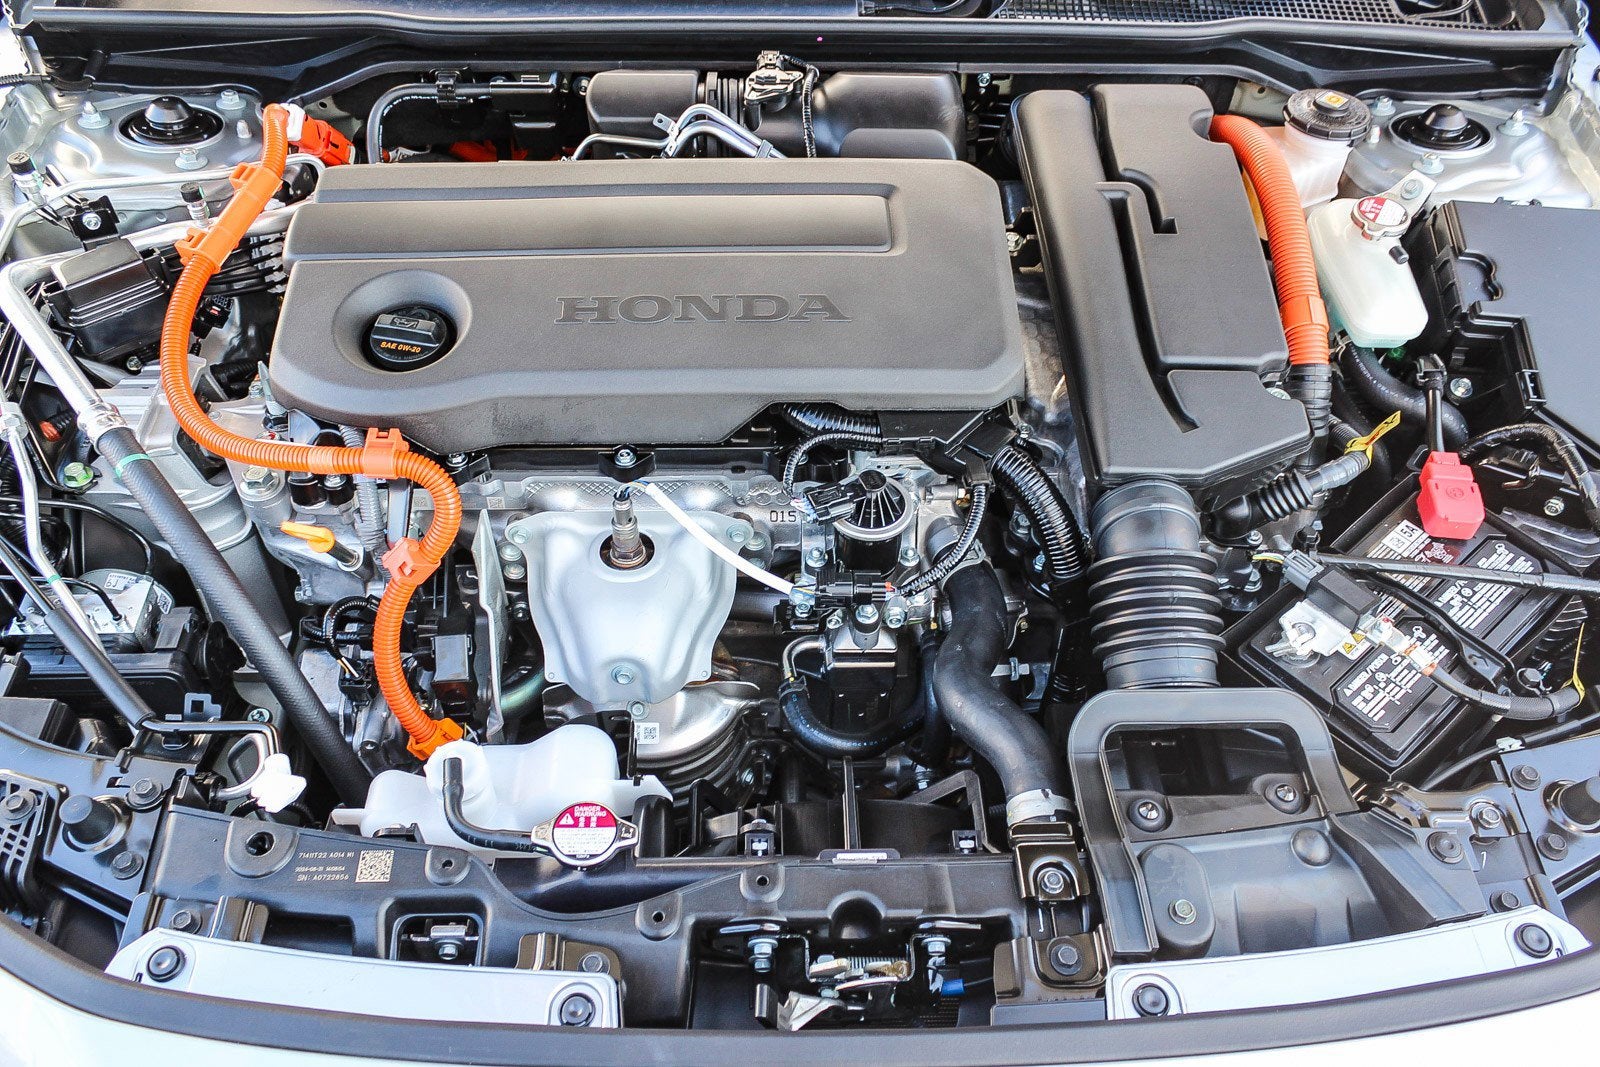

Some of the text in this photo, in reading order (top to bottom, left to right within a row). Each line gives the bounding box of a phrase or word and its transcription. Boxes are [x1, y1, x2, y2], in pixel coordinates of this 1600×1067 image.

[554, 294, 852, 324] HONDA
[380, 341, 421, 353] SAE 0W-20
[769, 509, 797, 523] 015
